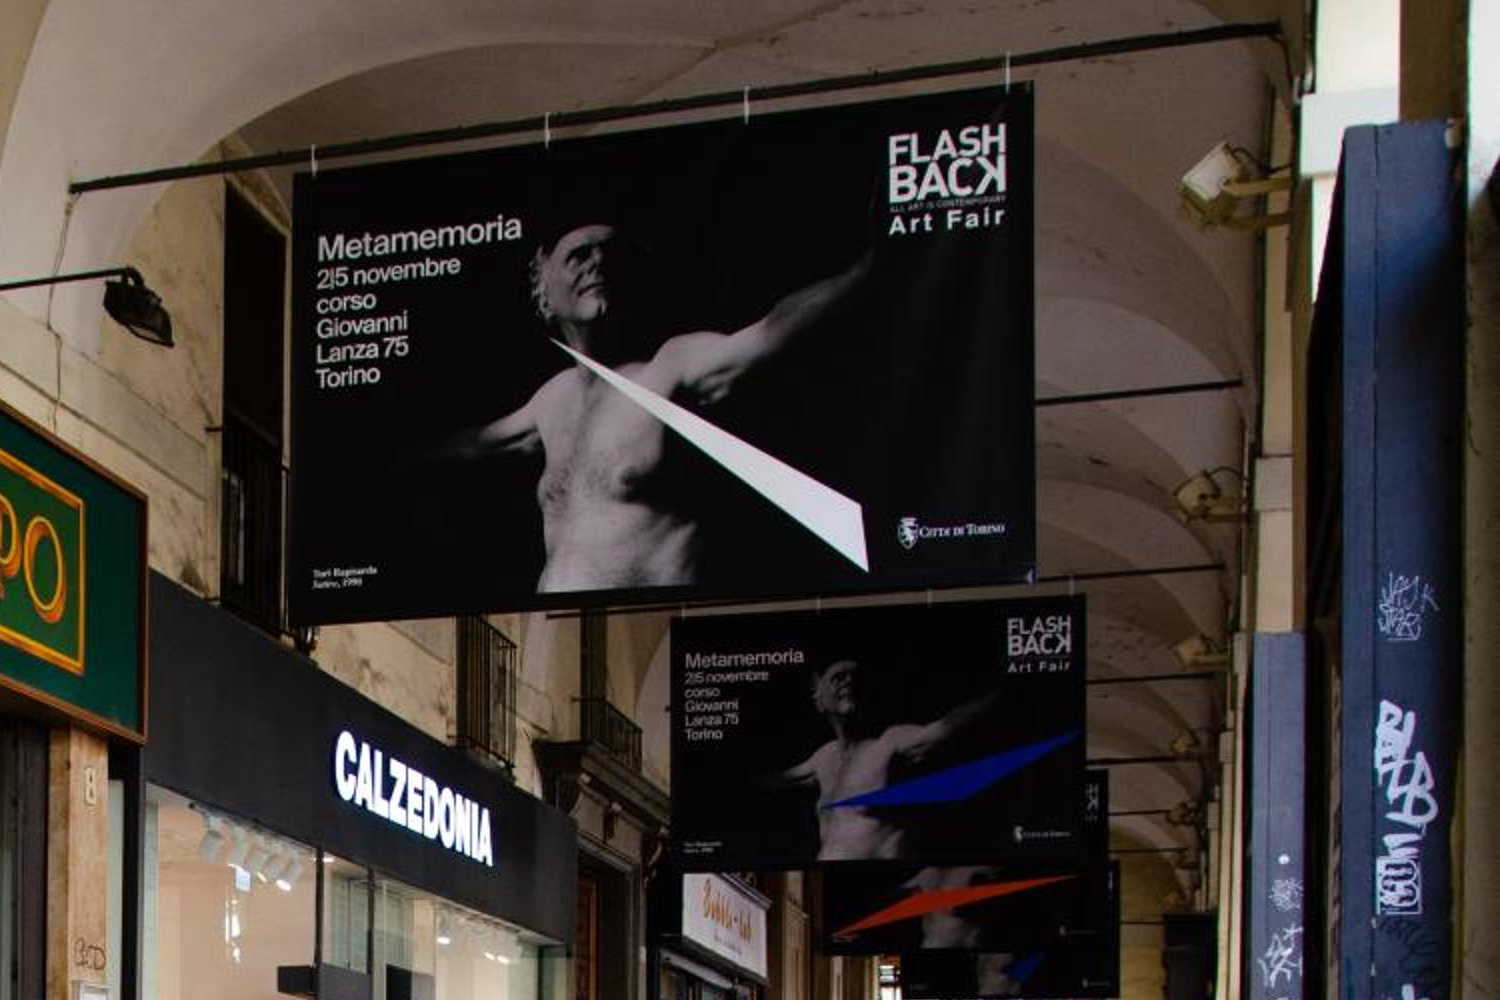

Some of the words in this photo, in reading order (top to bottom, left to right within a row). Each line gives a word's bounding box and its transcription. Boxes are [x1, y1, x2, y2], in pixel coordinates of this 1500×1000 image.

[889, 123, 1007, 166] FLASH
[889, 154, 1007, 203] BACK
[889, 214, 933, 235] Art
[947, 207, 1005, 230] Fair
[317, 213, 523, 263] Metamemoria
[353, 257, 461, 286] novembre
[316, 292, 377, 315] corso
[316, 310, 409, 338] Giovanni
[316, 343, 379, 364] Lanza
[383, 335, 409, 358] 75
[316, 366, 381, 389] Torino
[1007, 615, 1071, 636] FLASH
[1007, 633, 1071, 656] BACK
[684, 648, 804, 669] Metamemoria
[684, 687, 720, 699] corso
[684, 699, 739, 713] Giovanni
[685, 714, 722, 727] Lanza
[684, 728, 723, 741] Torino
[335, 731, 493, 867] CALZEDONIA
